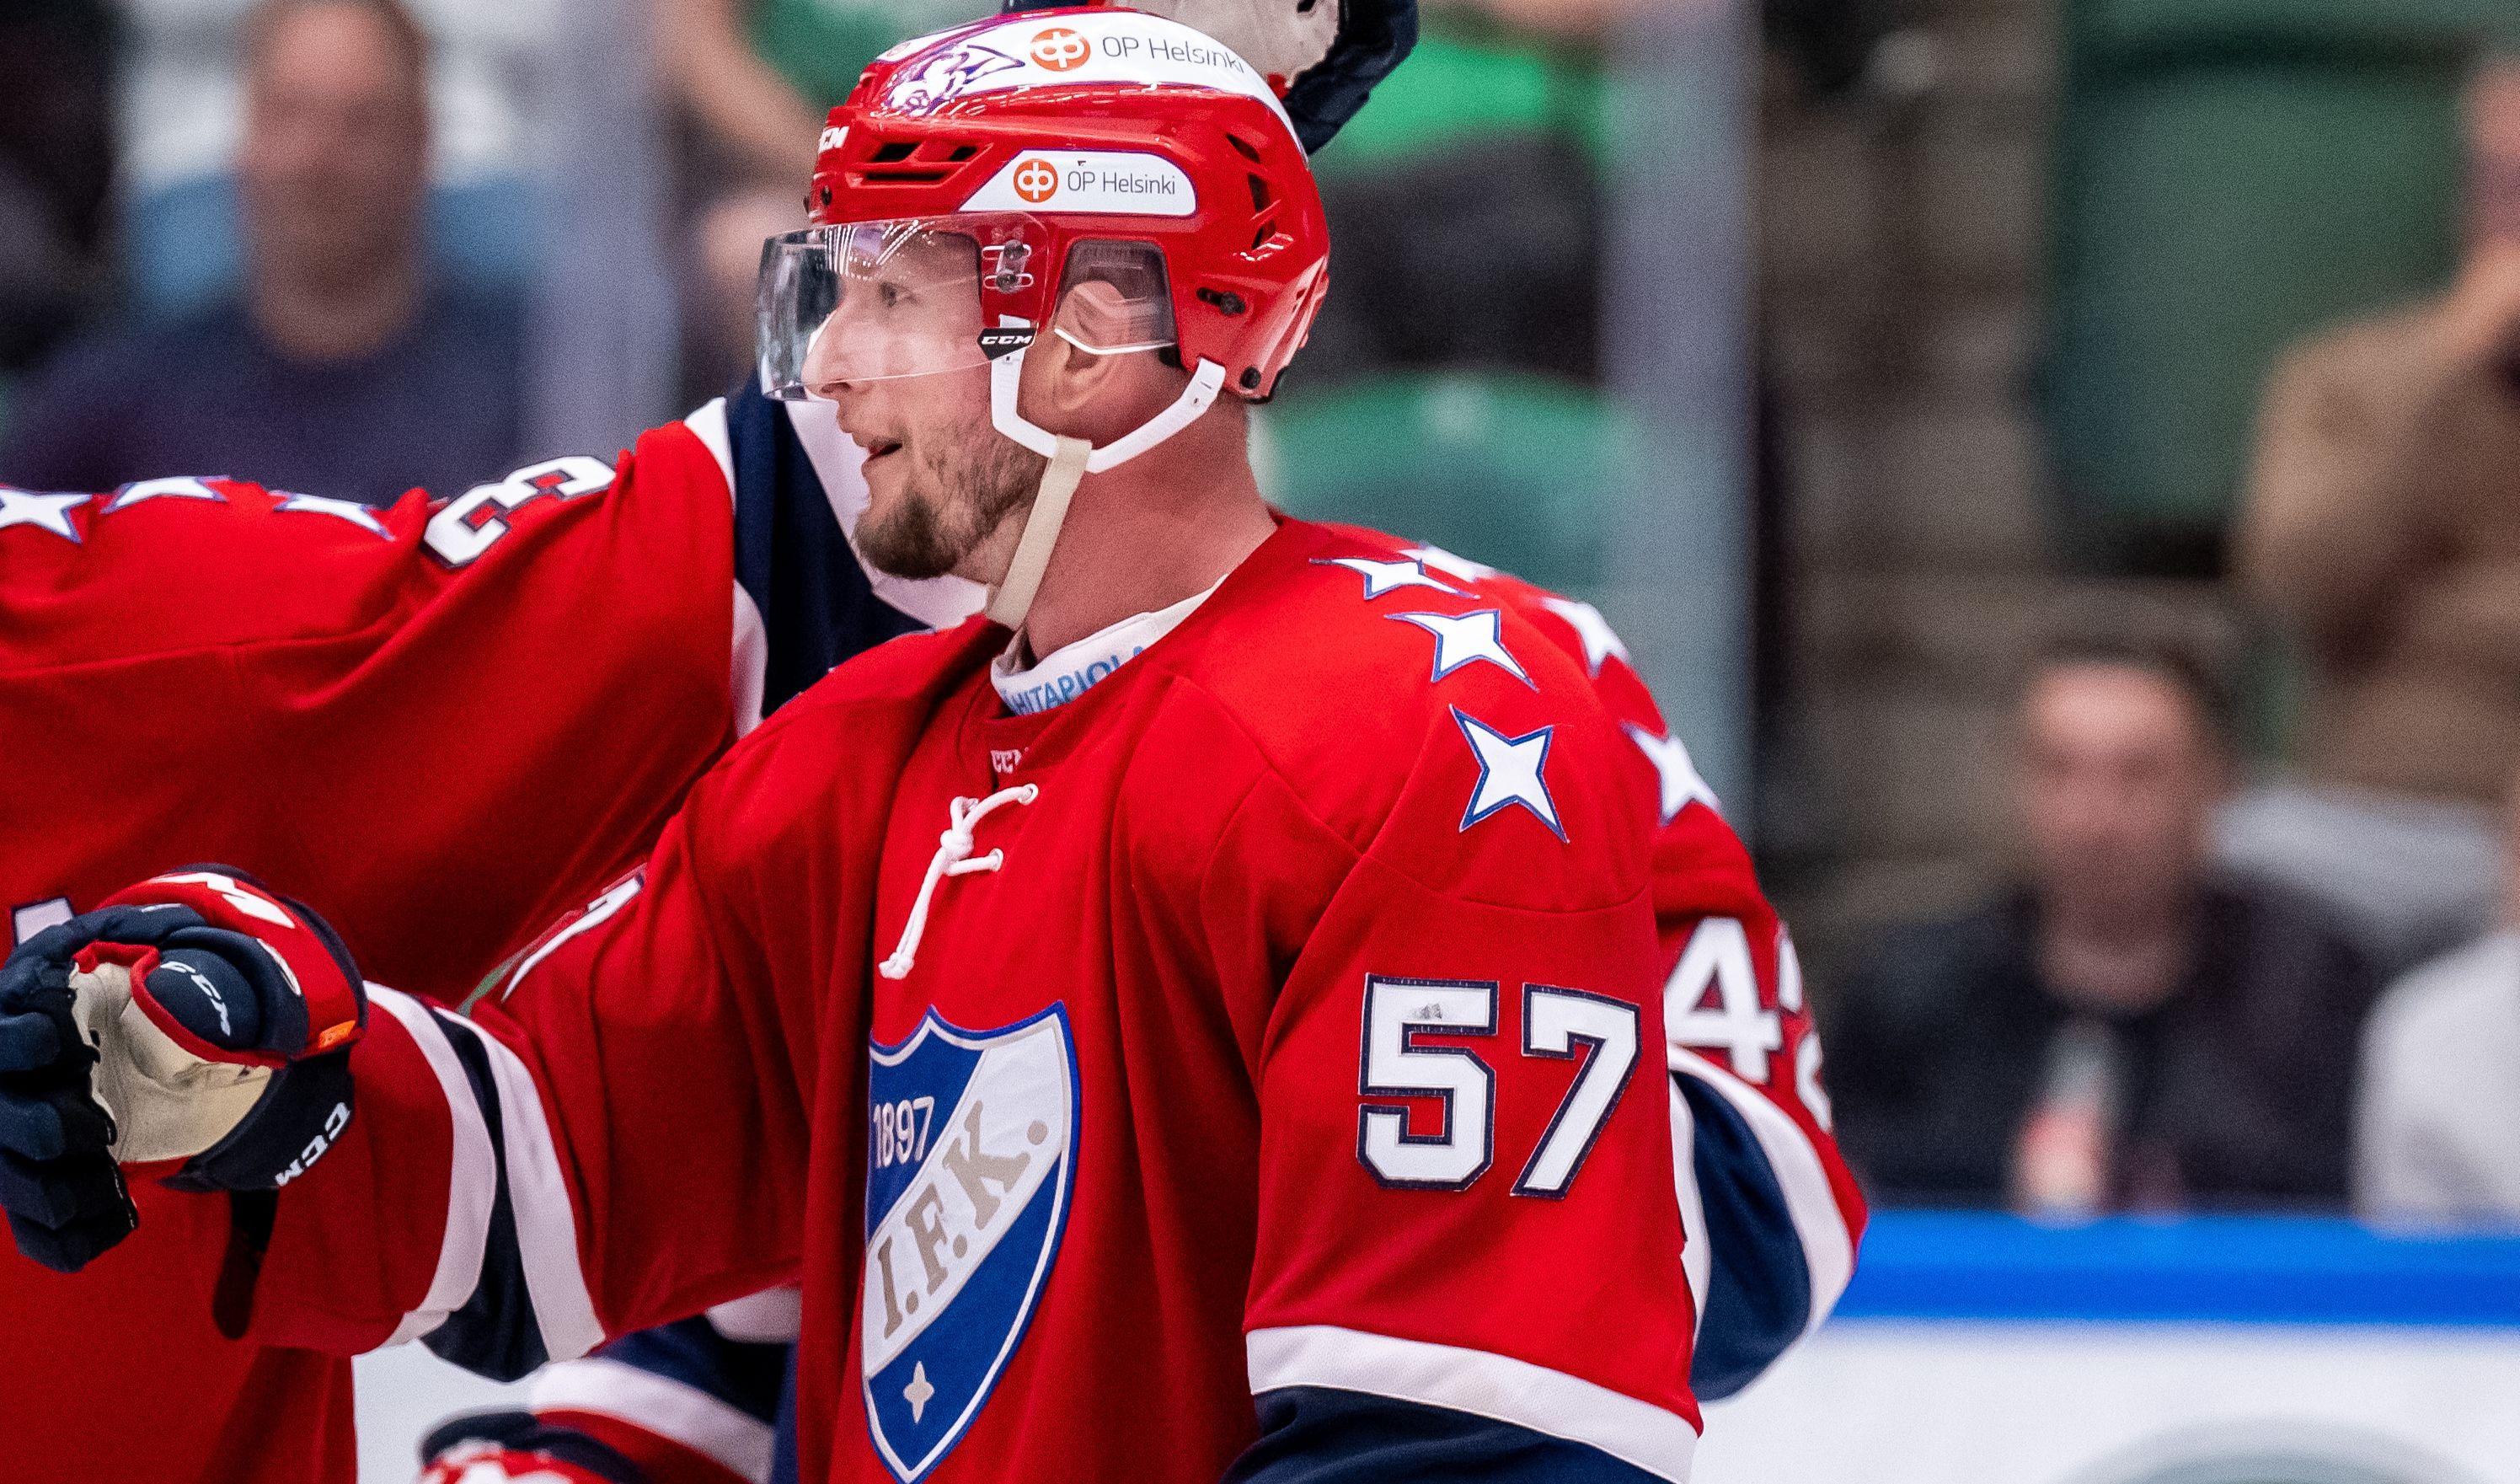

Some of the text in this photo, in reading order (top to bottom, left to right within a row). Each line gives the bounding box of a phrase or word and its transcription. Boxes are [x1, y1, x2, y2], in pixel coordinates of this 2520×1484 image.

[1102, 36, 1140, 58] OP
[1148, 37, 1245, 74] Helsinki
[817, 126, 850, 154] CM
[1067, 170, 1095, 192] OP
[1102, 171, 1176, 196] Helsinki
[981, 335, 1033, 346] CCM
[1000, 646, 1143, 716] HITAPIO
[160, 961, 232, 1037] CCM
[1356, 972, 1644, 1200] 57
[274, 1101, 351, 1187] CCM
[872, 1096, 935, 1170] 1897
[875, 1100, 1049, 1341] I.F.K.
